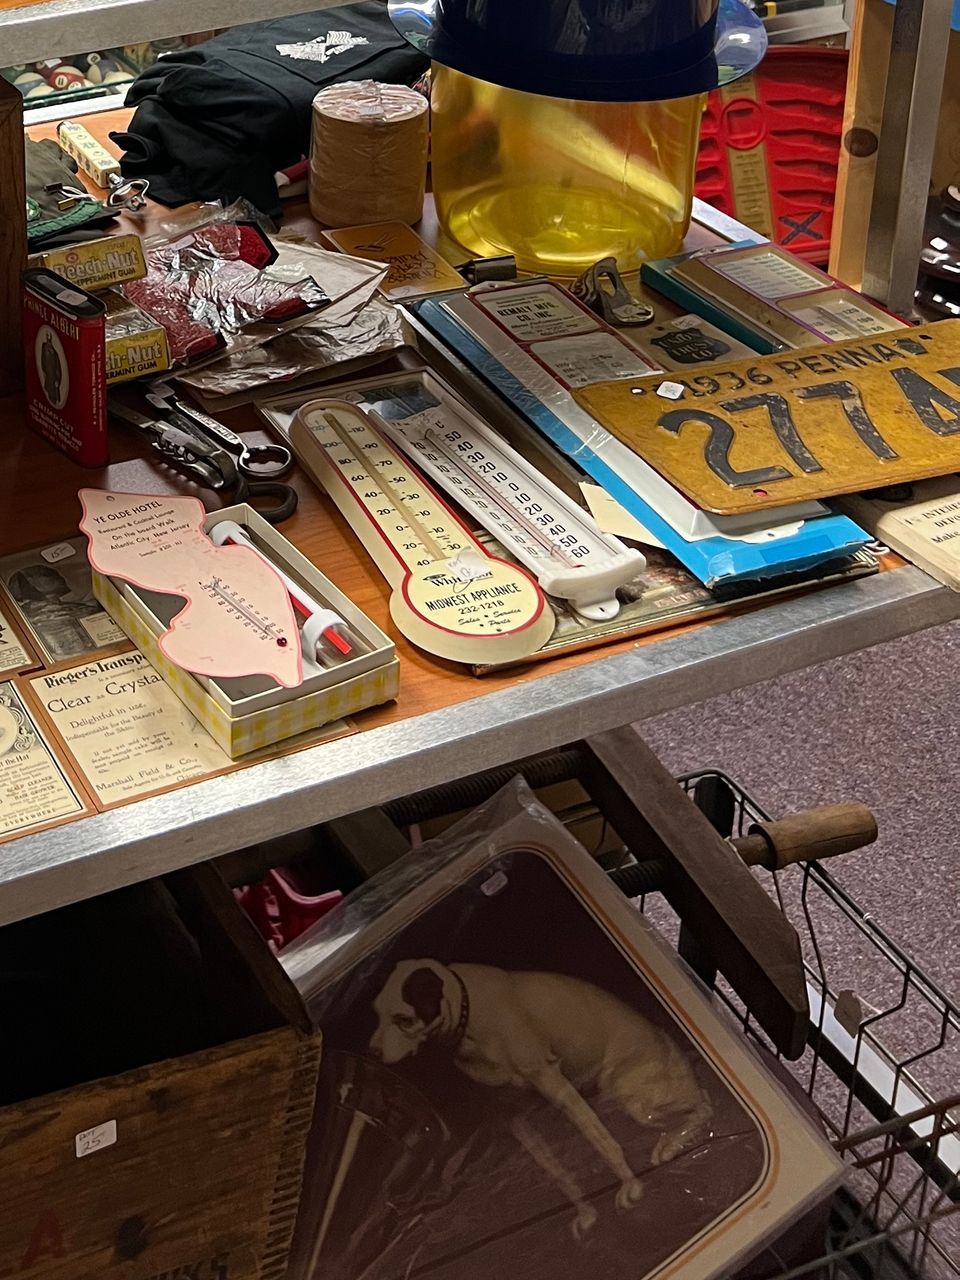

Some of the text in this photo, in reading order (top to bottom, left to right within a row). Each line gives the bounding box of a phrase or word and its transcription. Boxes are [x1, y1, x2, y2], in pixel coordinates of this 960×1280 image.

[52, 249, 139, 279] Beech-Nut
[118, 269, 136, 278] GUM
[24, 294, 80, 341] PRINCE ALBERT
[137, 360, 157, 371] GUM
[775, 343, 906, 378] PENNA
[445, 431, 462, 440] 50
[458, 442, 474, 452] 40
[469, 452, 485, 462] 30
[480, 462, 496, 472] 20
[492, 472, 507, 482] 10
[510, 482, 519, 492] 0
[515, 493, 531, 503] 10
[93, 500, 162, 525] YE OLDE HOTEL
[526, 504, 542, 515] 20
[537, 514, 554, 525] 30
[153, 529, 168, 539] New
[549, 525, 566, 536] 40
[561, 536, 578, 546] 50
[931, 530, 960, 543] Make
[571, 546, 590, 558] 60
[425, 583, 522, 611] MIDWEST APPLIANCE
[44, 665, 97, 689] Rieger's
[47, 694, 91, 713] Clear
[70, 706, 126, 730] Delightful in
[15, 753, 30, 764] Hat
[95, 767, 160, 792] Marshall Field
[4, 808, 56, 828] EVERYWHERE
